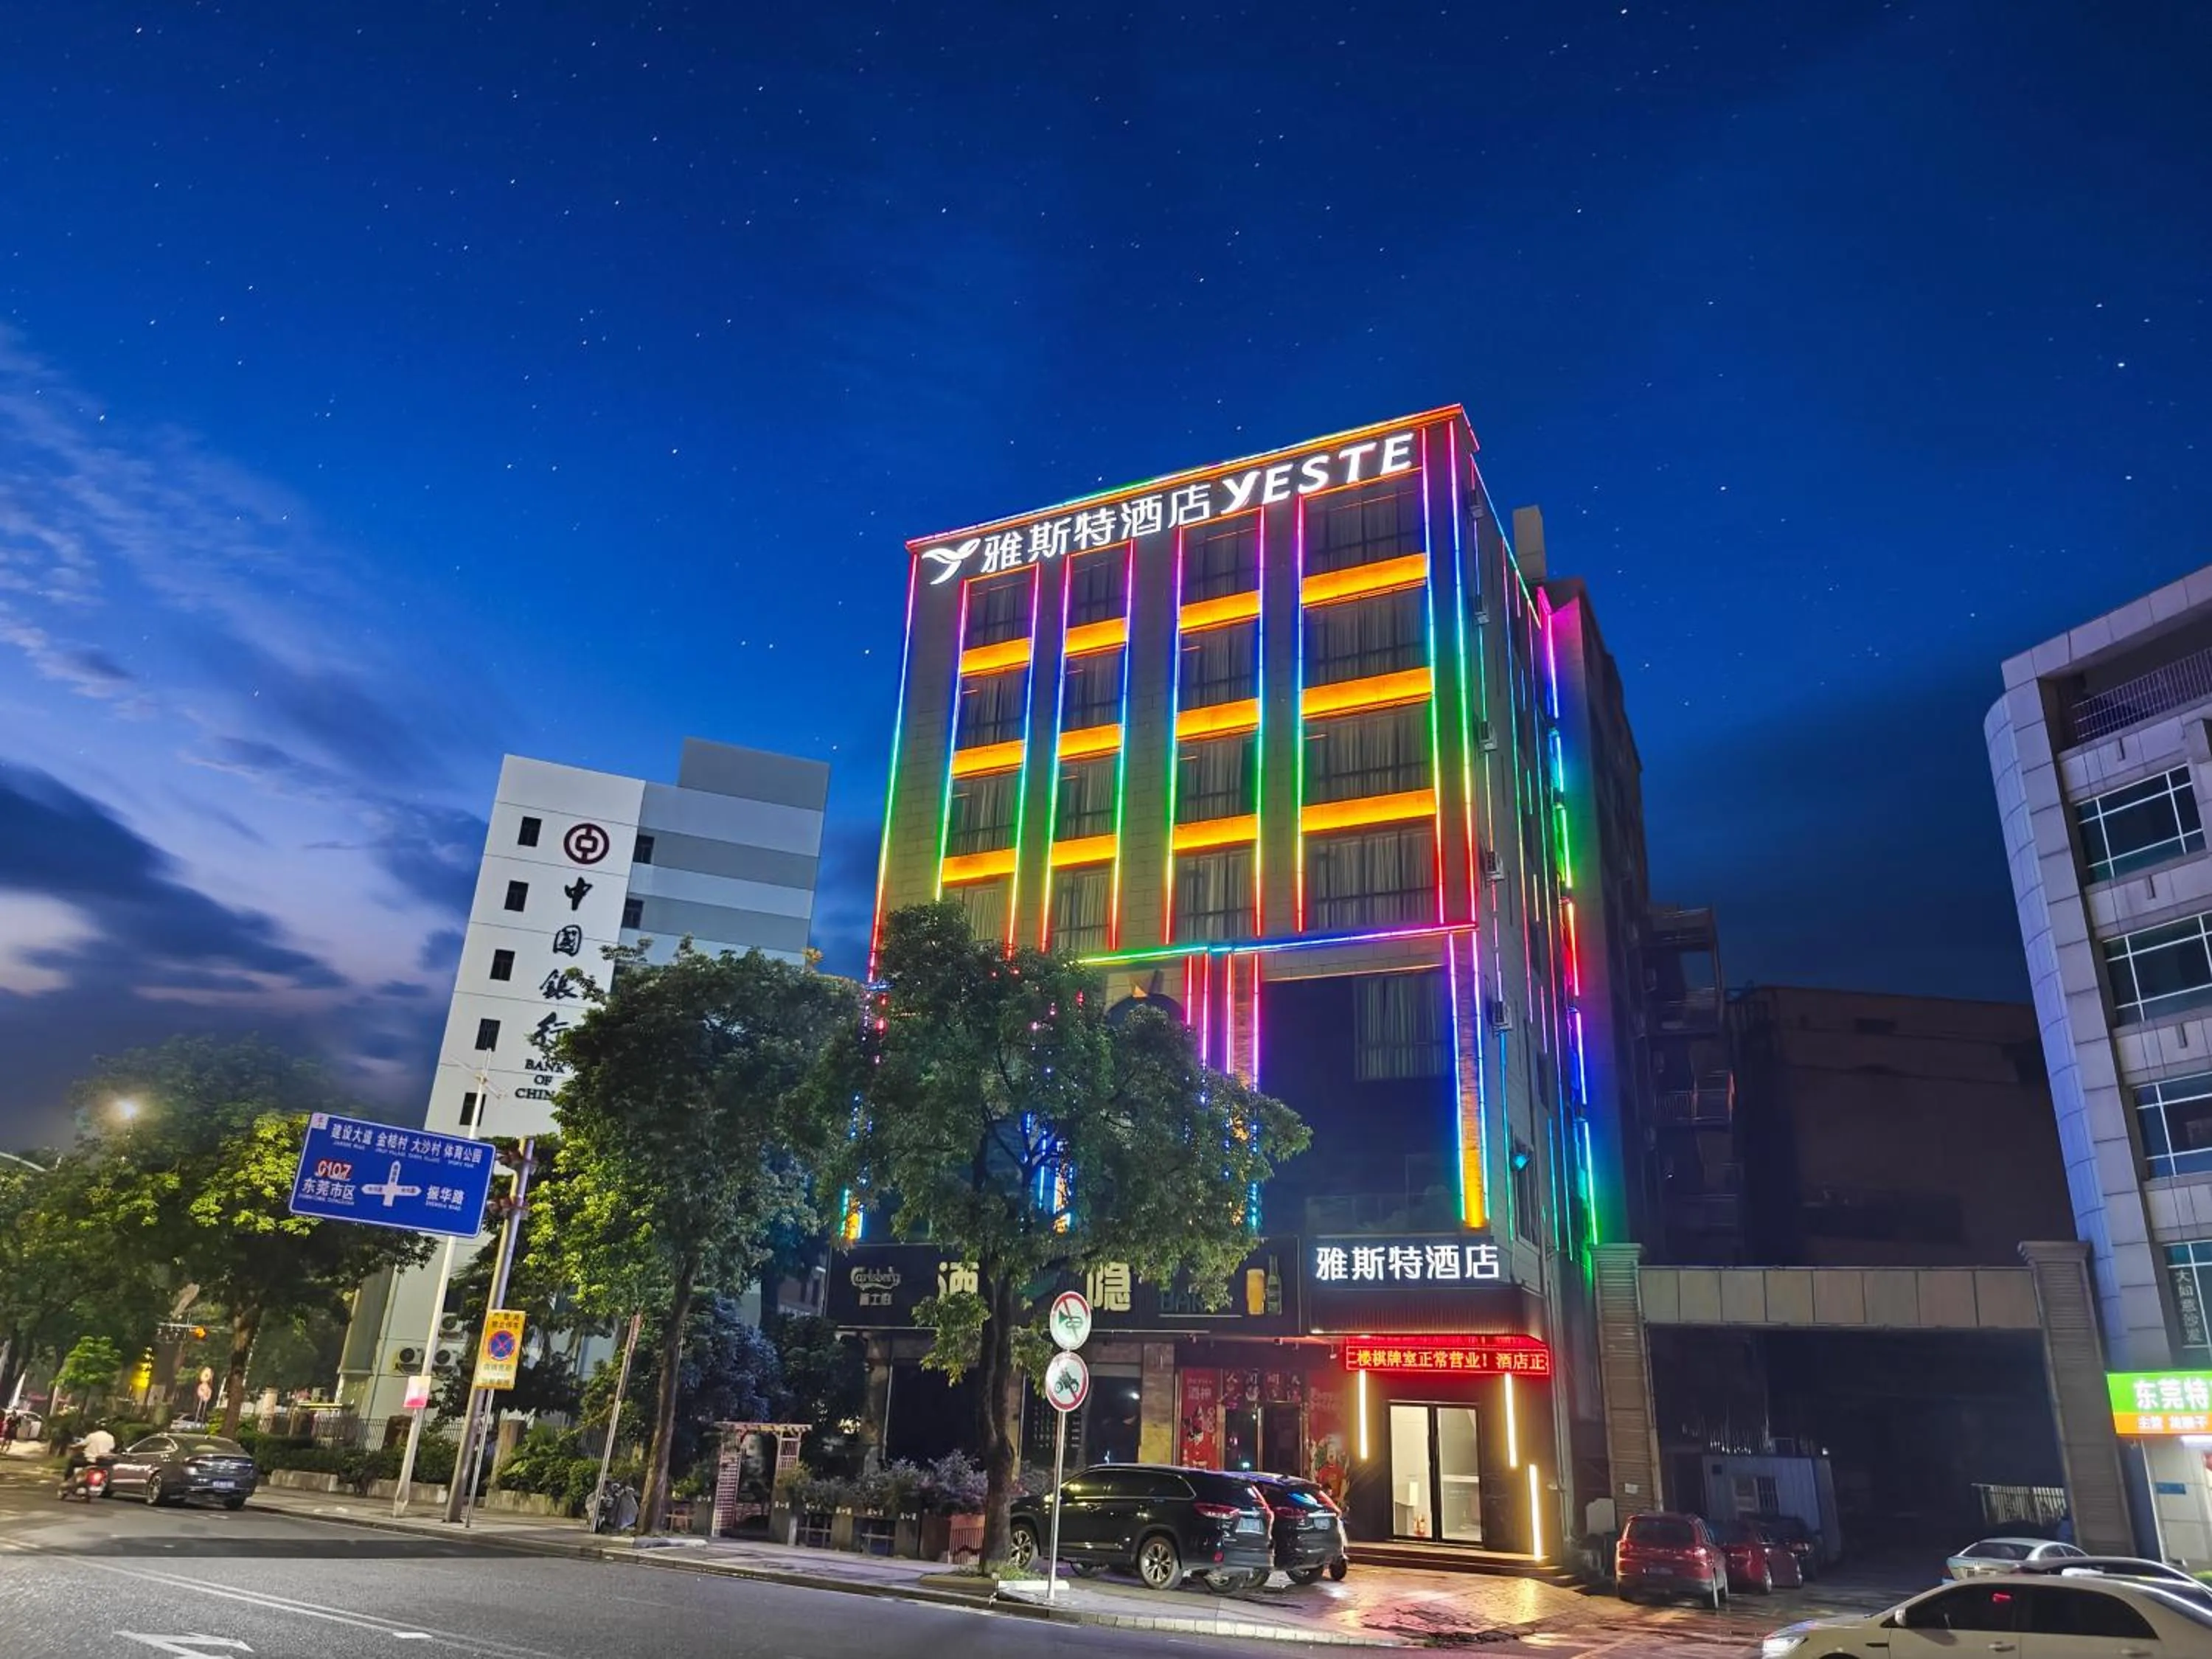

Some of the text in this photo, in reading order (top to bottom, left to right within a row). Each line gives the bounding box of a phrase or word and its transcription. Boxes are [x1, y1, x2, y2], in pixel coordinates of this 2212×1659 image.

[981, 484, 1211, 574] 雅斯特酒店
[524, 1058, 566, 1074] BANK
[534, 1074, 554, 1086] OF
[515, 1088, 557, 1101] CHIN
[331, 1123, 373, 1145] 建设大道
[411, 1138, 442, 1157] 大沙村
[444, 1144, 483, 1164] 体育公园
[302, 1177, 356, 1200] 东莞市区
[426, 1184, 465, 1205] 振华路
[1315, 1245, 1500, 1281] 雅斯特酒店
[849, 1266, 902, 1290] Carlsberg
[1086, 1262, 1133, 1312] 隐
[1495, 1352, 1548, 1371] 酒店正
[2134, 1377, 2212, 1410] 东莞特
